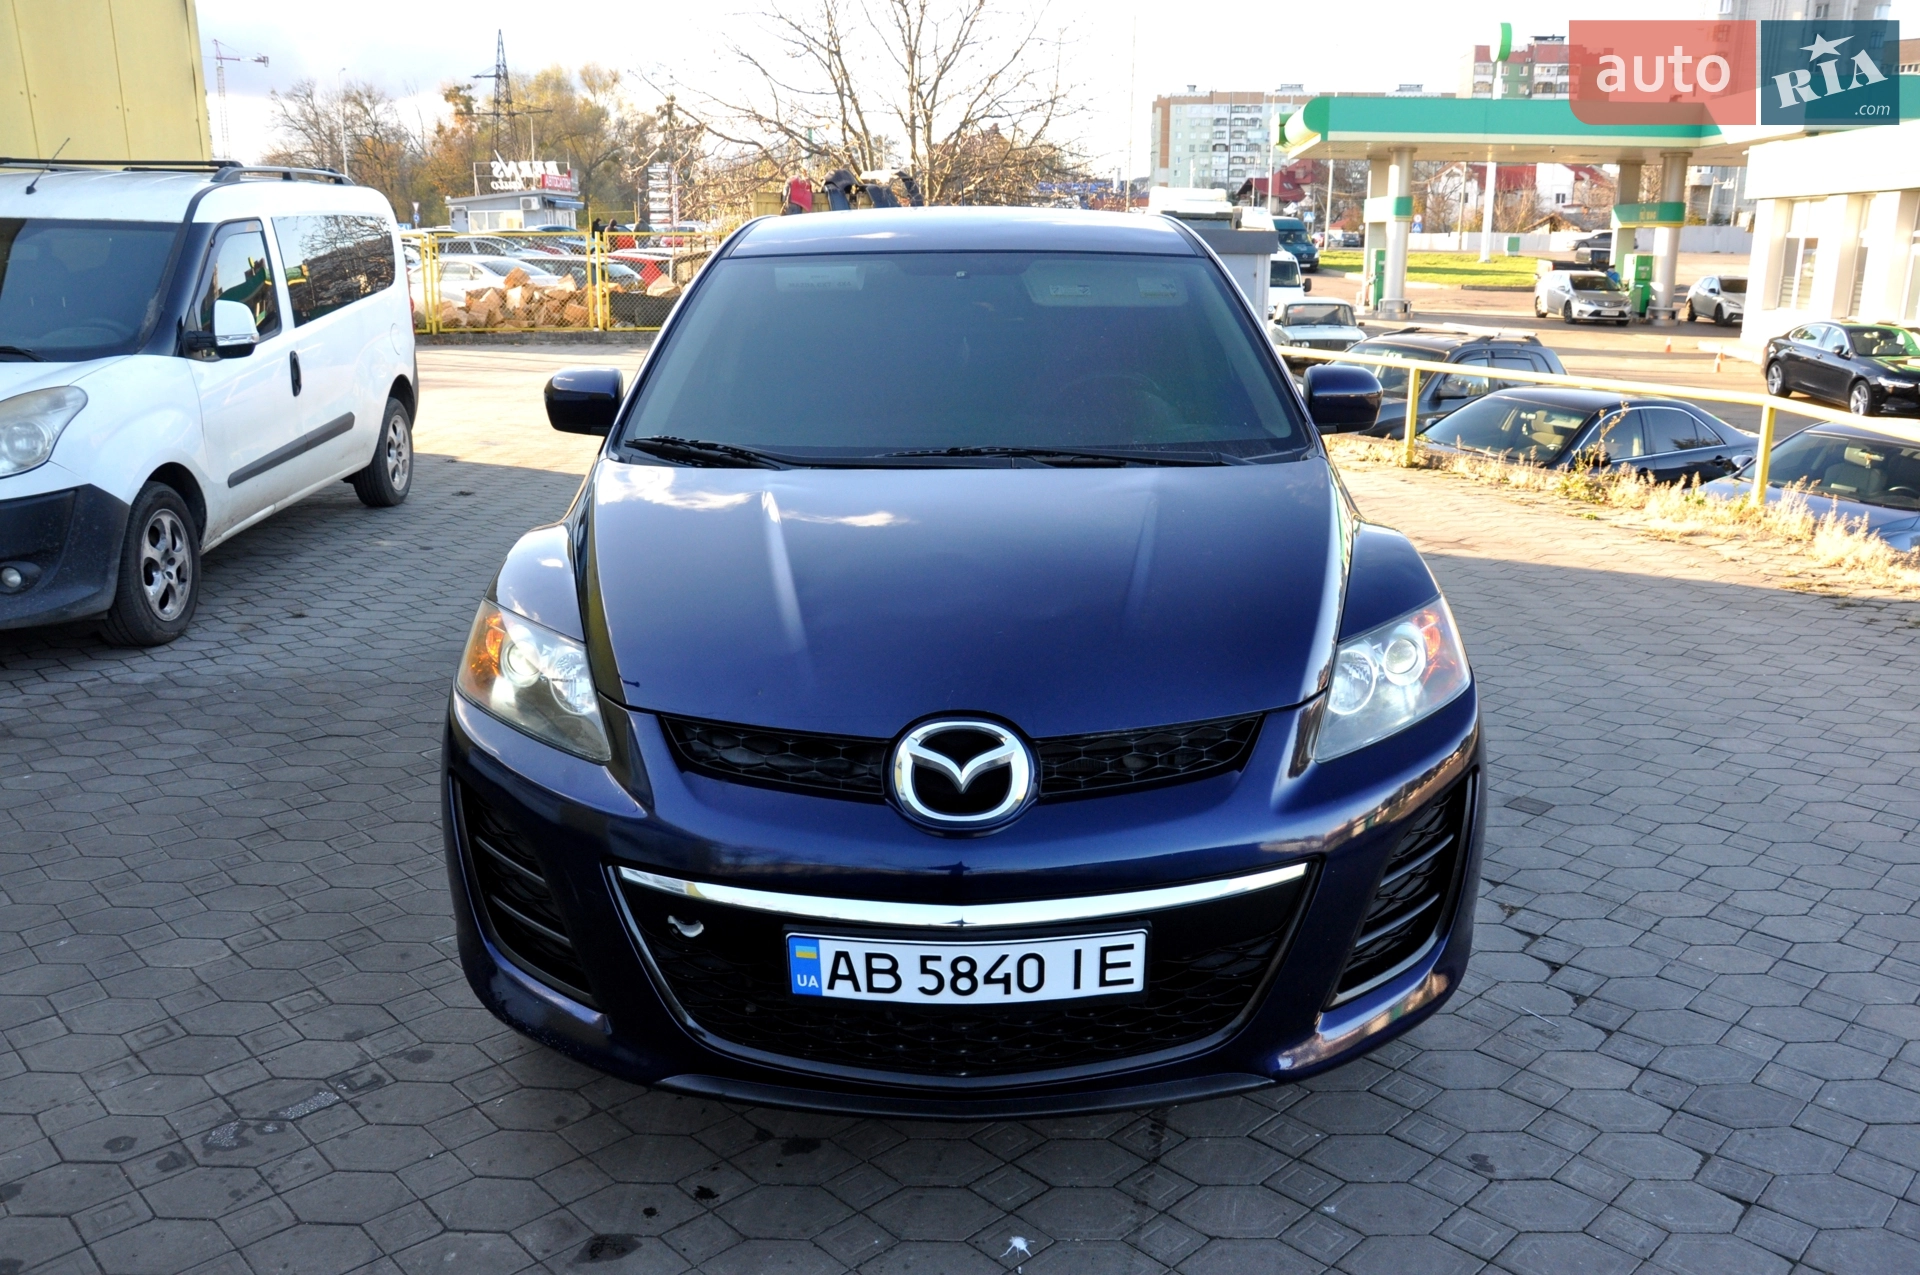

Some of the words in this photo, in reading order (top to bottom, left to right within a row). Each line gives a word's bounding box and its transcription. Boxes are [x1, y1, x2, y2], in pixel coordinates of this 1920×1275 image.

[796, 973, 819, 988] UA
[827, 949, 903, 993] AB
[917, 952, 1045, 996] 5840
[1072, 943, 1135, 990] IE
